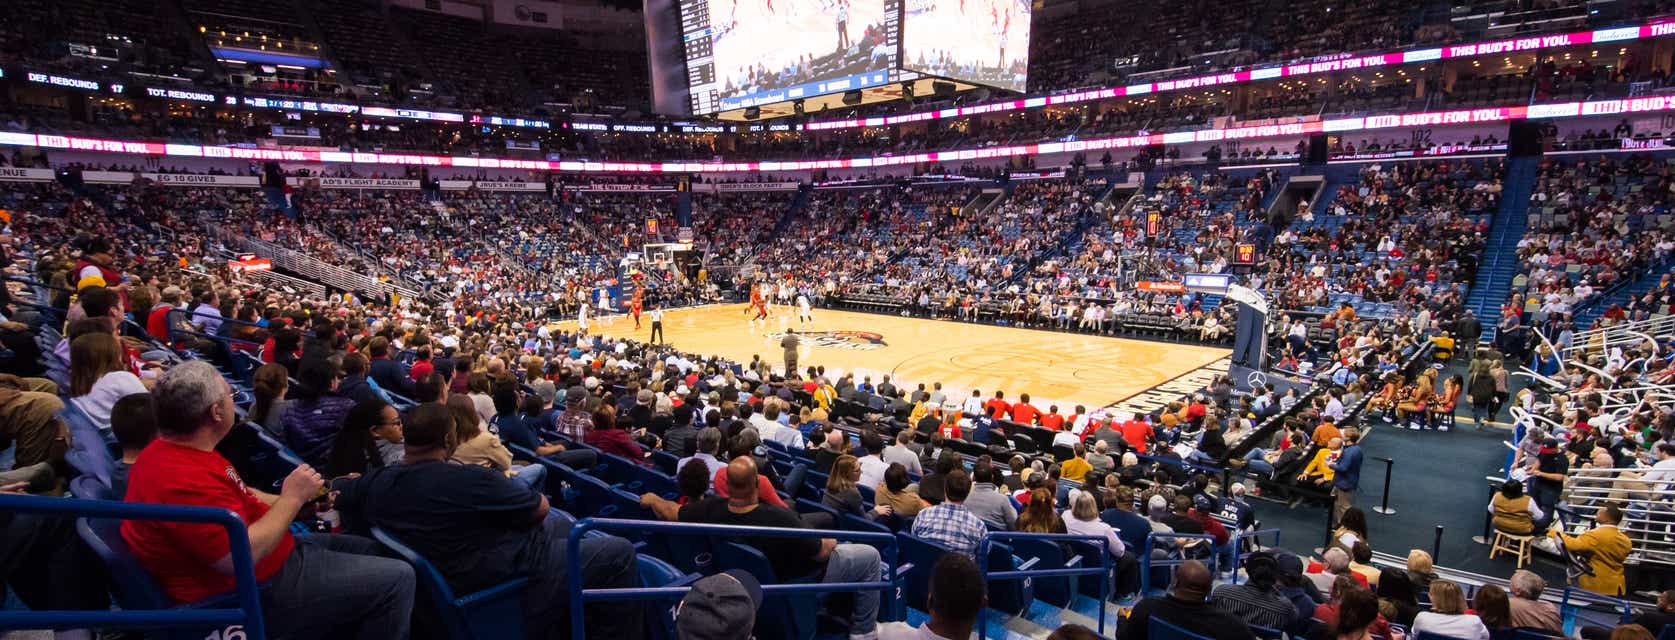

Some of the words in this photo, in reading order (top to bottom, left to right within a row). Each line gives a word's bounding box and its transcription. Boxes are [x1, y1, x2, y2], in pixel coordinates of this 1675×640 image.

[1450, 45, 1476, 57] THIS
[1478, 40, 1514, 54] BUD'S
[1516, 38, 1540, 49] FOR
[1542, 34, 1571, 47] YOU.
[1288, 64, 1310, 75] THIS
[1311, 60, 1339, 73] BUD'S
[1341, 58, 1361, 69] FOR
[1363, 55, 1387, 65] YOU.
[28, 72, 49, 83] DEF.
[49, 76, 99, 90] REBOUNDS
[111, 84, 123, 93] 17
[1157, 80, 1174, 91] THIS
[1176, 77, 1199, 89] BUD'S
[1201, 75, 1217, 86] FOR
[1218, 73, 1237, 83] YOU.
[147, 87, 167, 97] TOT.
[167, 90, 215, 102] REBOUNDS
[1050, 95, 1064, 104] THIS
[1065, 92, 1085, 103] BUD'S
[1086, 90, 1099, 99] FOR
[1100, 88, 1116, 97] YOU.
[1372, 115, 1400, 127] THIS
[1402, 113, 1442, 126] BUD'S
[1443, 110, 1470, 123] FOR
[1472, 108, 1504, 121] YOU.
[1202, 128, 1224, 140] THIS
[1225, 126, 1256, 139] BUD'S
[1257, 124, 1278, 137] FOR
[1279, 122, 1304, 135] YOU.
[1411, 128, 1432, 143] 102
[46, 136, 69, 148] THIS
[71, 138, 103, 150] BUD'S
[104, 141, 123, 151] FOR
[124, 143, 150, 153] YOU.
[1070, 141, 1086, 151] THIS
[1087, 139, 1111, 149] BUD'S
[1112, 137, 1128, 147] FOR
[1129, 136, 1150, 145] YOU.
[209, 147, 231, 157] THIS
[233, 149, 261, 158] BUD'S
[262, 150, 282, 159] FOR
[283, 151, 306, 160] YOU.
[157, 174, 170, 182] EG
[174, 174, 185, 182] 10
[187, 175, 216, 183] GIVES
[1242, 253, 1250, 261] 10
[1024, 576, 1032, 589] 10
